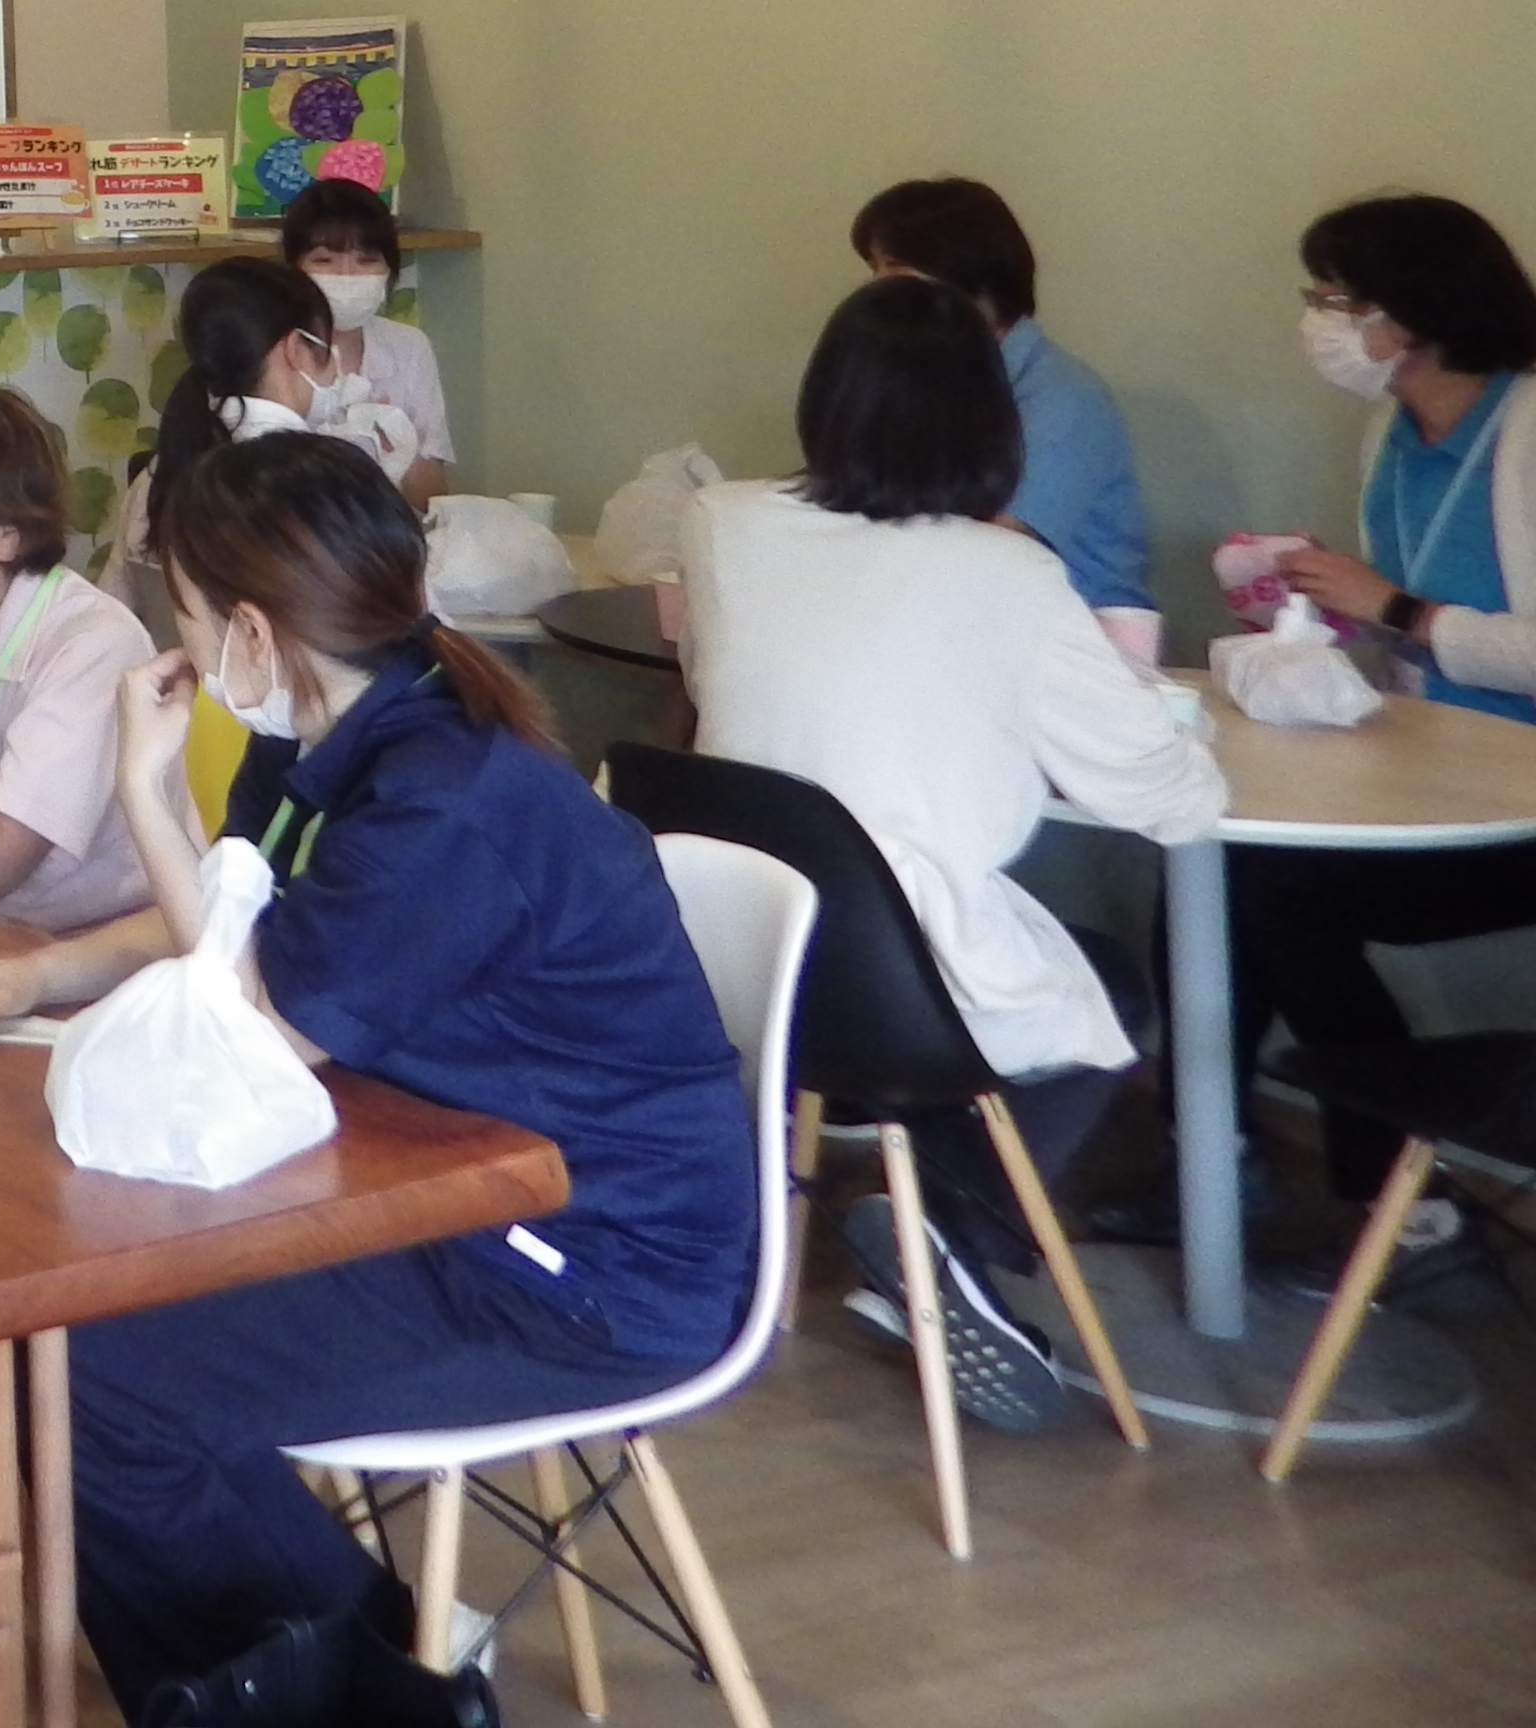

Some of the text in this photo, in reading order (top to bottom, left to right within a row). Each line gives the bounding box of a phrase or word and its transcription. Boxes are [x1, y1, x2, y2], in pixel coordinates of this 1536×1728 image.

[90, 153, 219, 170] れ筋デザートランキング
